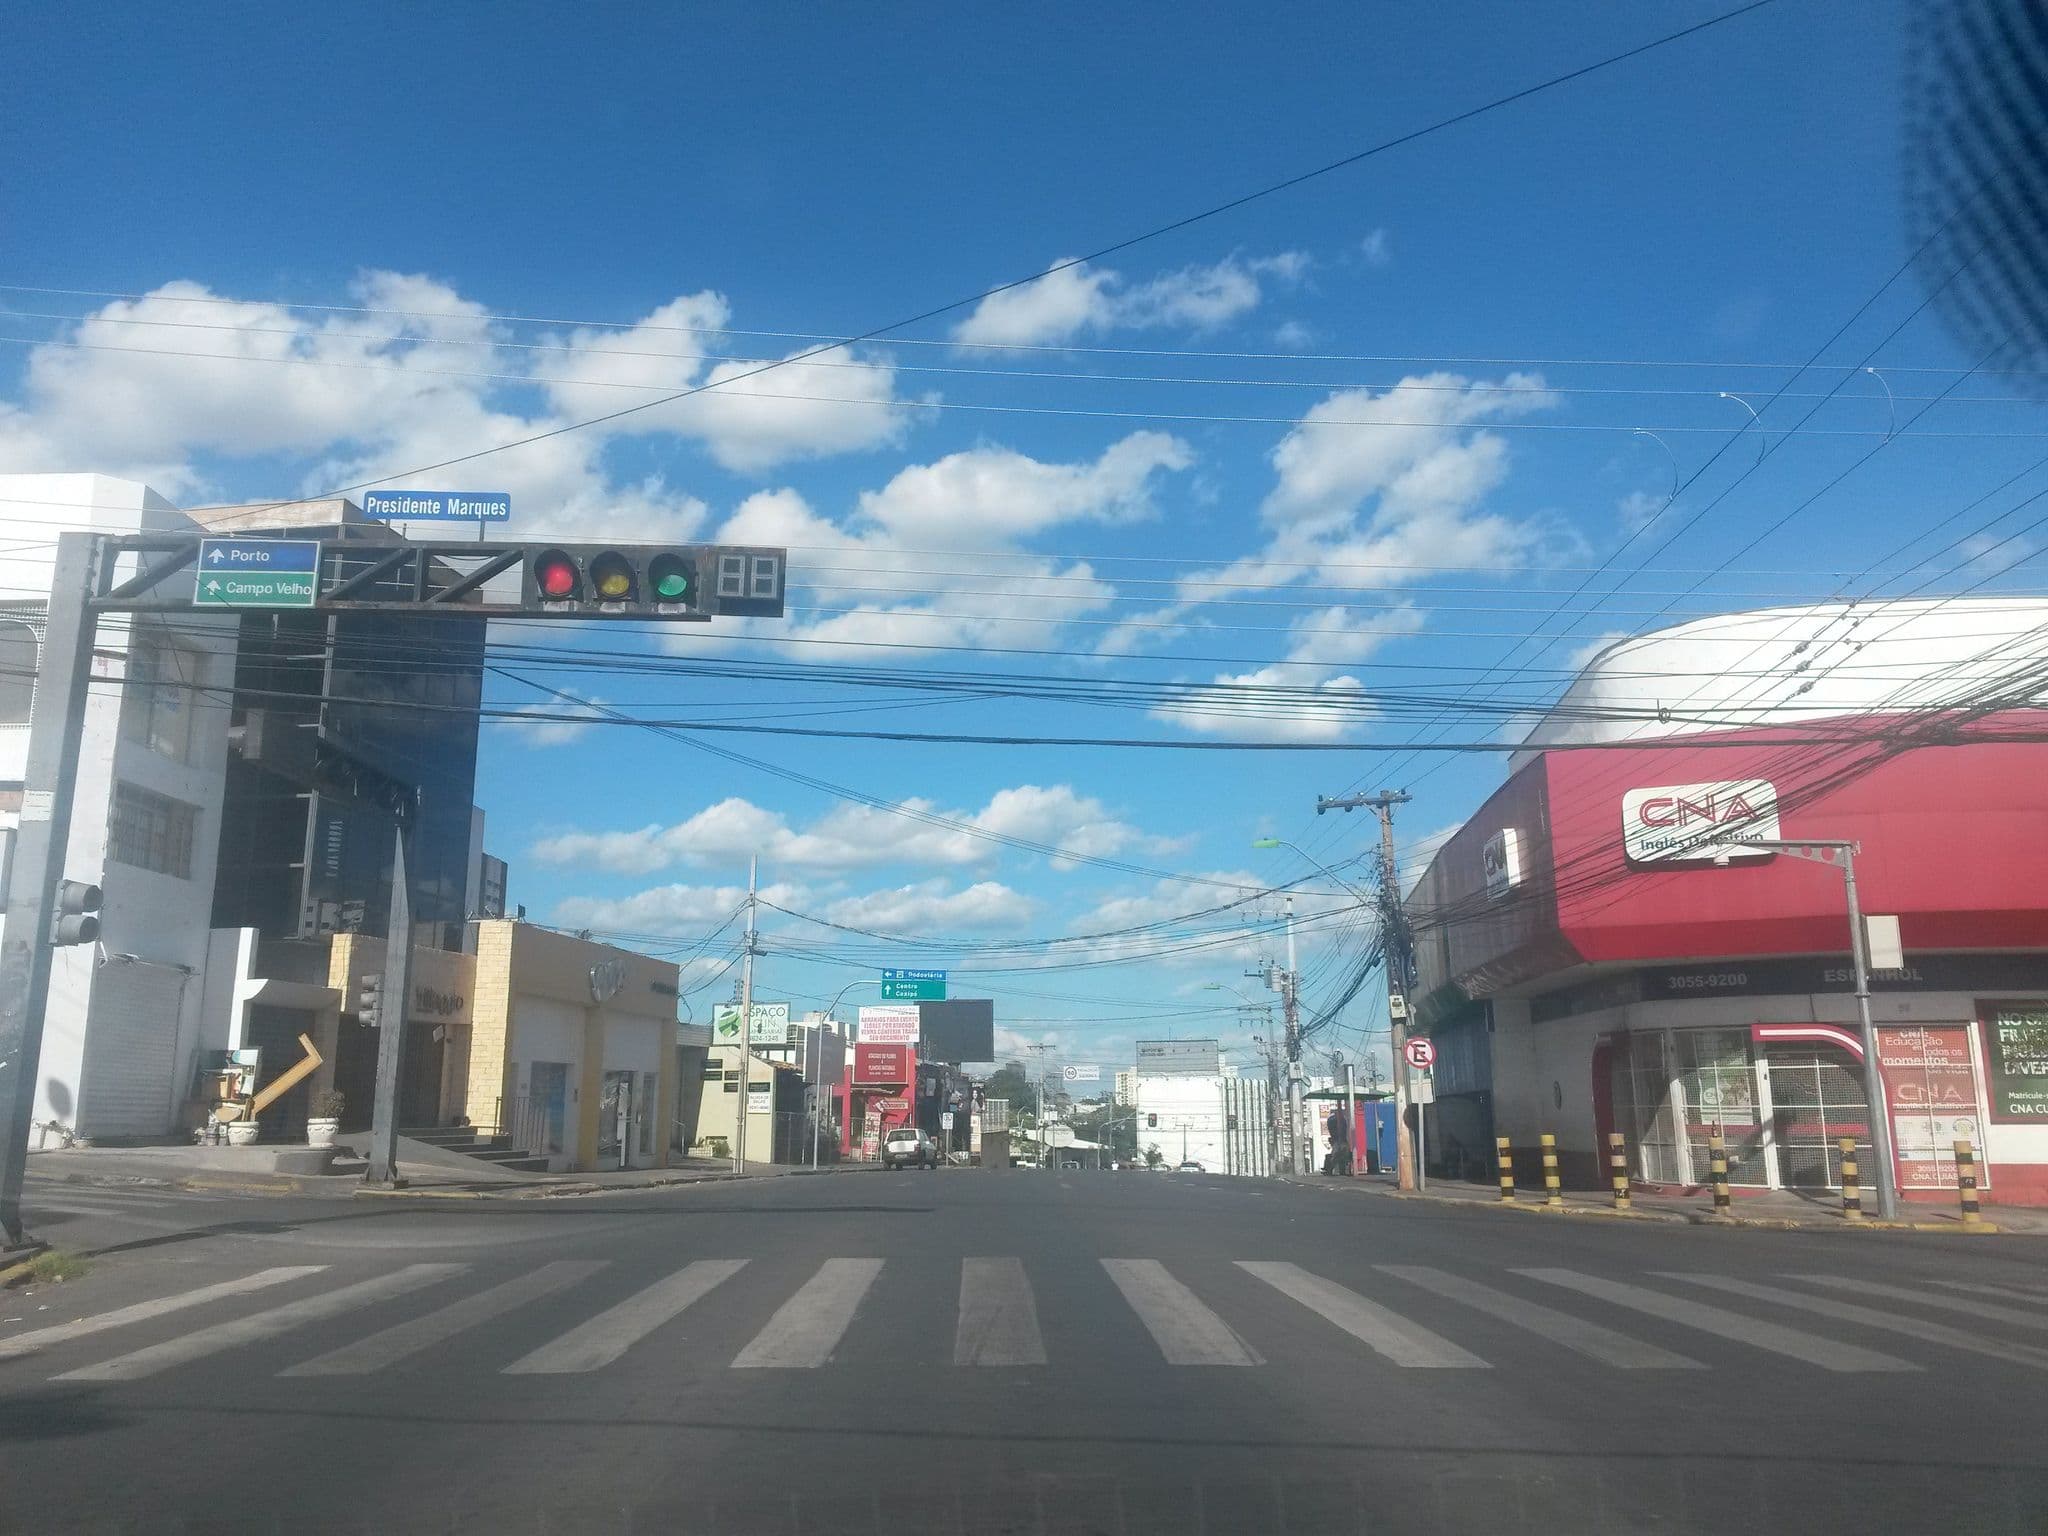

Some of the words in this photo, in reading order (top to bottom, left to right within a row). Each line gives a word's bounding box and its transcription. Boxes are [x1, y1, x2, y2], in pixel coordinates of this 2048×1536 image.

[367, 496, 440, 516] Presidente
[447, 498, 506, 520] Marques
[231, 550, 270, 562] Porto
[226, 582, 273, 599] Campo
[276, 582, 312, 596] Velho
[1639, 793, 1760, 828] CNA
[749, 1007, 786, 1019] SPAÇO
[2008, 1091, 2048, 1100] Matricule-
[2010, 1104, 2034, 1114] CNA
